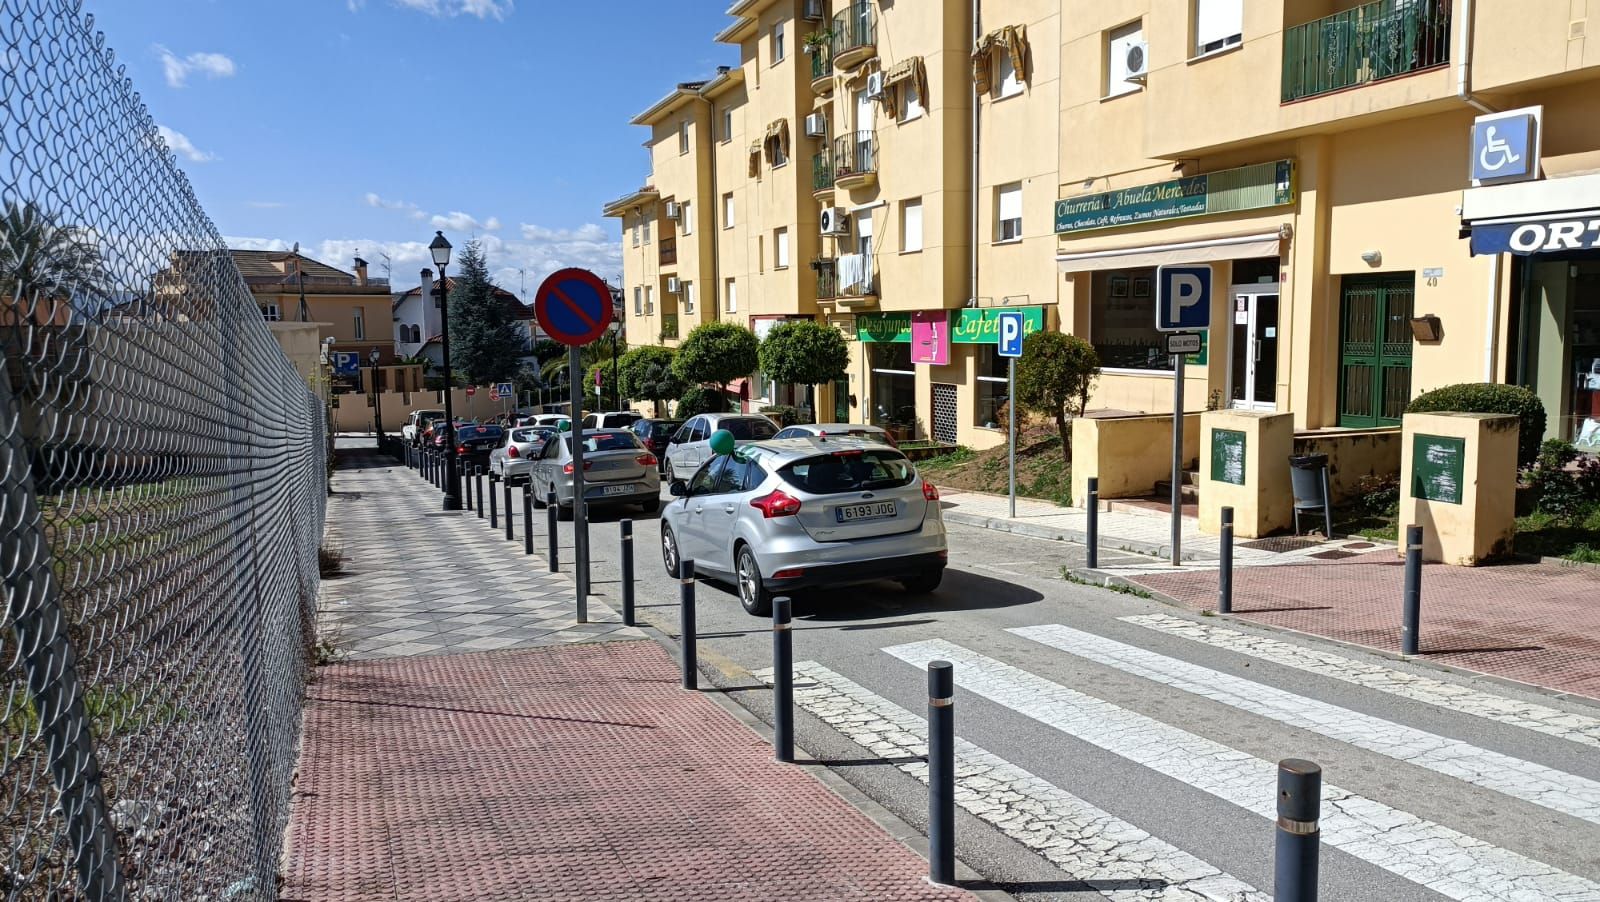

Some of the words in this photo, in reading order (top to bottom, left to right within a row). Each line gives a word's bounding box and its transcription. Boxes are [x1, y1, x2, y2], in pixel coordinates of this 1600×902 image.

[1112, 186, 1152, 210] Abuela
[1152, 178, 1206, 201] Mercedes
[1426, 277, 1438, 288] 40
[1169, 273, 1203, 323] P
[1002, 316, 1018, 352] P
[337, 353, 351, 368] P
[845, 506, 872, 518] 6193
[874, 503, 894, 515] JDG
